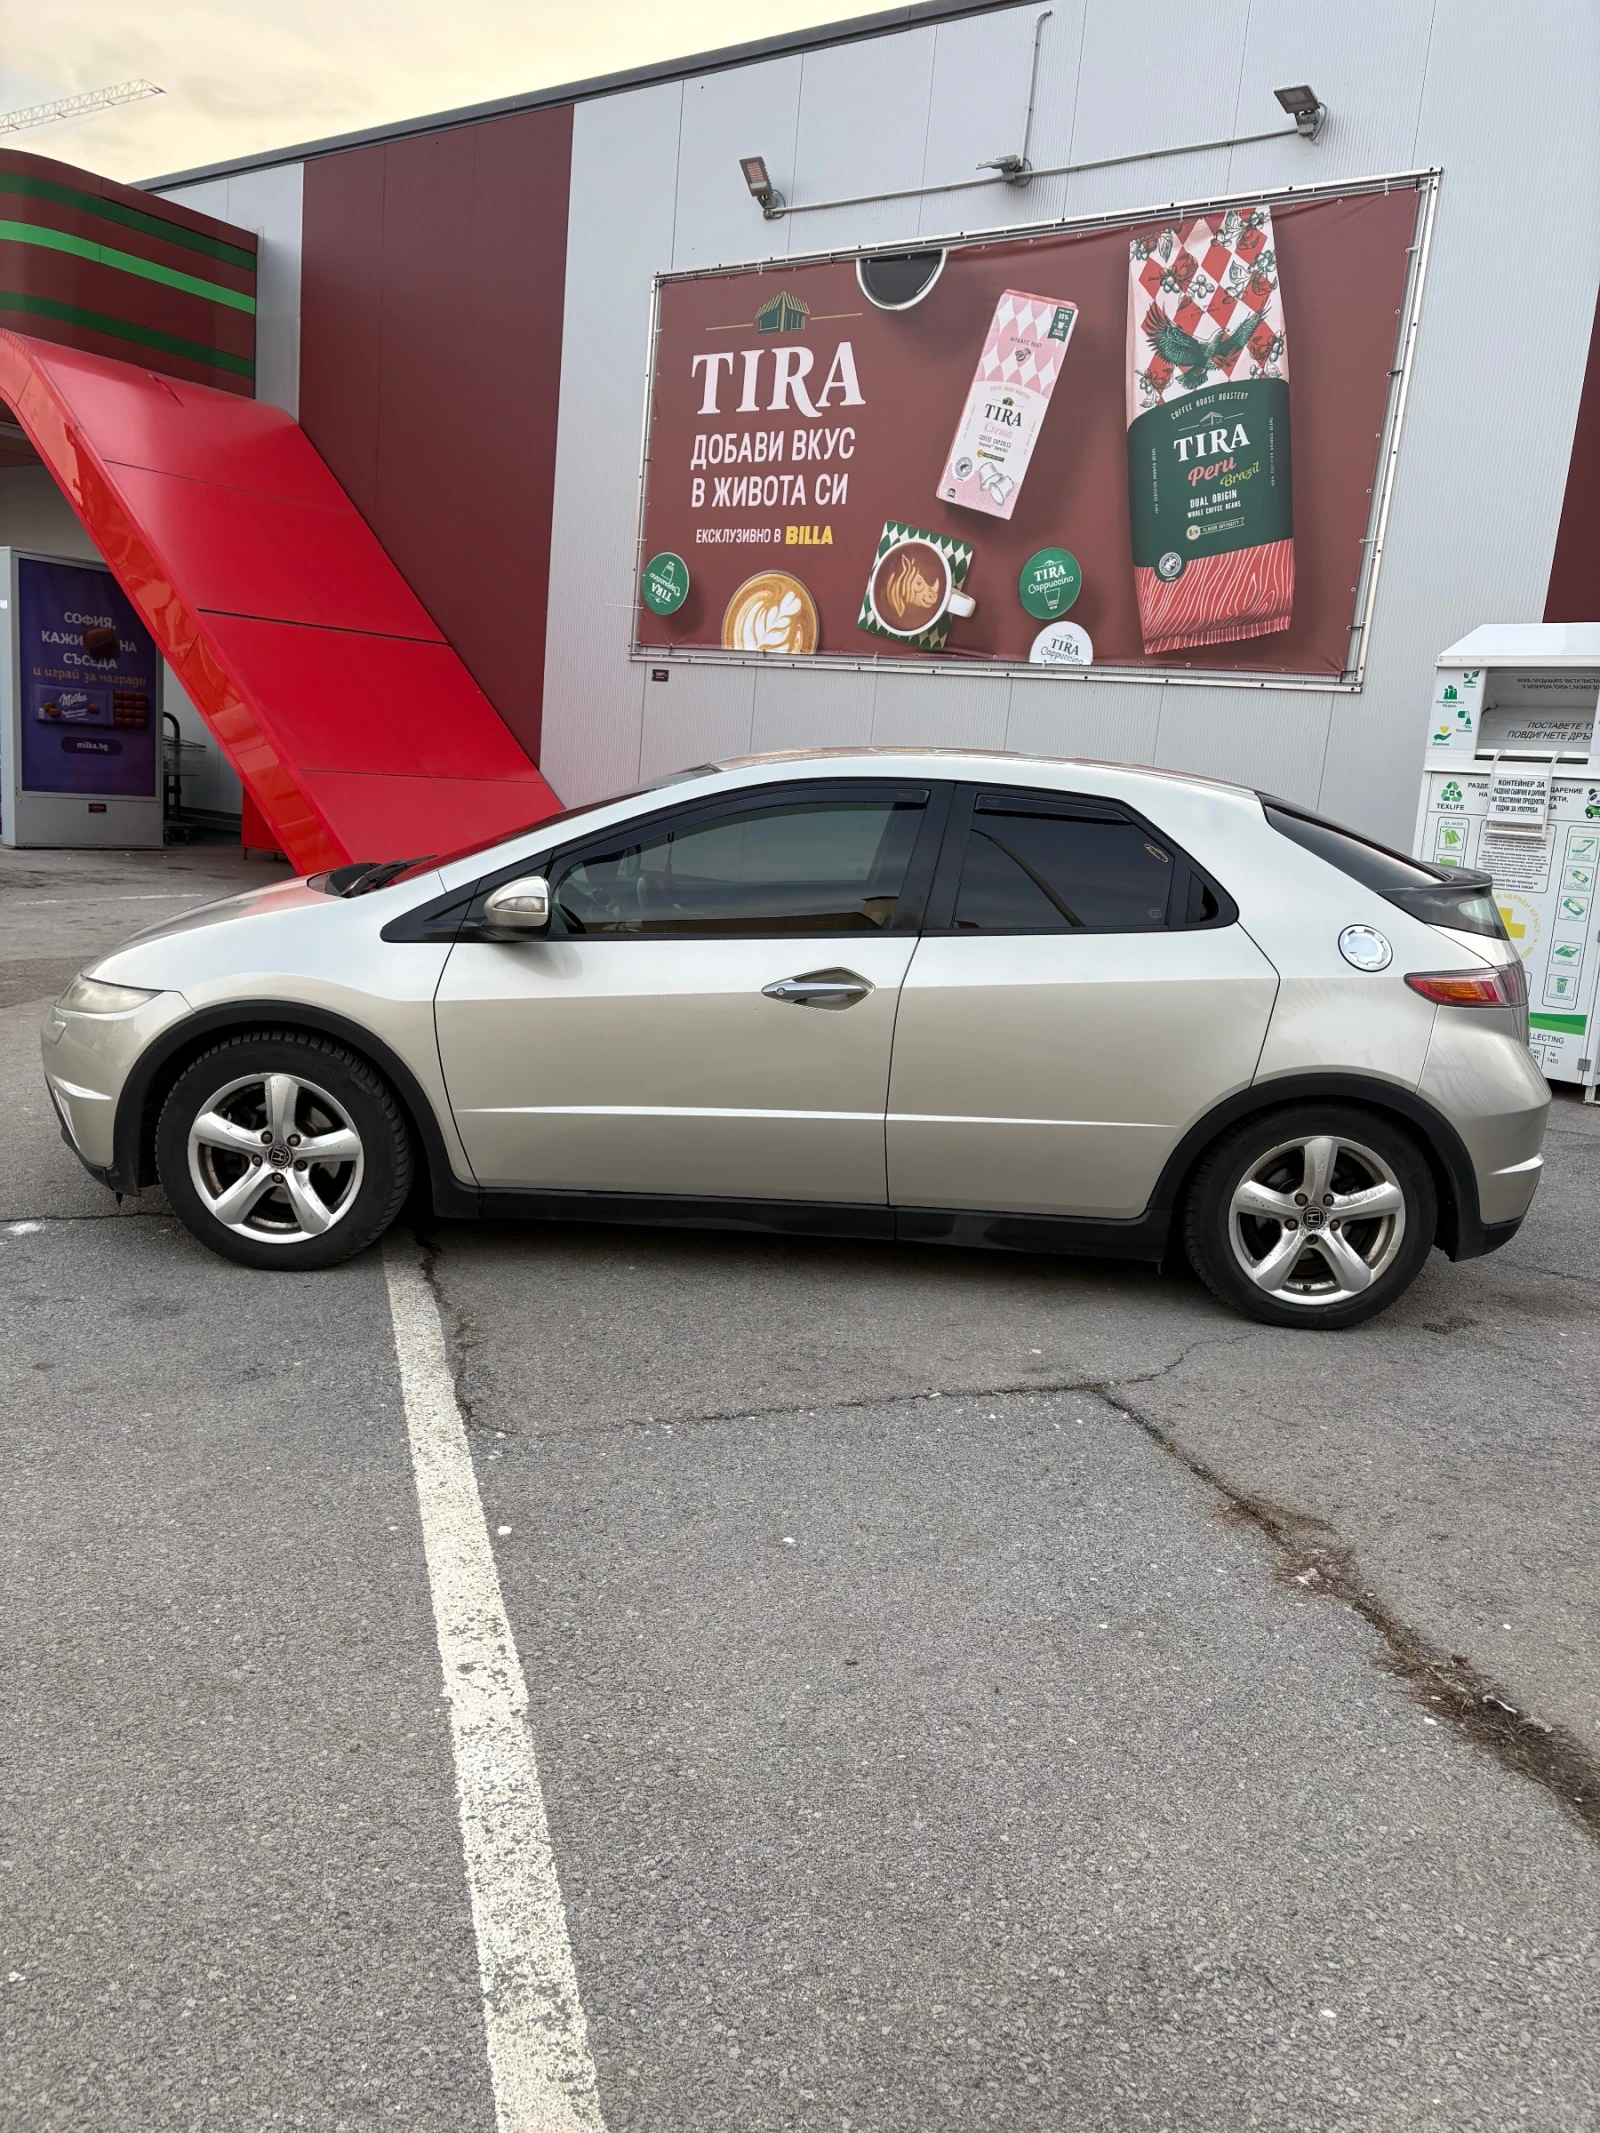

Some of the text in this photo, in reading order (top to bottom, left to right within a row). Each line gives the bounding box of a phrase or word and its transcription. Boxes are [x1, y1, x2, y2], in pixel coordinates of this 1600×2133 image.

[691, 341, 866, 417] TIRA
[985, 403, 1022, 427] TIRA
[1170, 392, 1249, 420] COFFEE HOUSE ROASTERY
[984, 421, 1013, 438] Crema
[690, 427, 855, 470] ДОБАВИ ВКУС
[1173, 423, 1251, 462] TIRA
[1188, 457, 1237, 487] Peru
[1220, 461, 1261, 487] Brazil
[691, 473, 848, 507] В ЖИВОТА СИ
[1190, 489, 1237, 509] DUAL ORIGIN
[1187, 500, 1242, 518] WHOLE COFFEE BEANS
[696, 526, 833, 545] ЕКСКЛУЗИВНО В BILLA
[1034, 565, 1066, 582] TIRA
[651, 582, 672, 602] TIRA
[1028, 575, 1074, 594] Cappuccino
[64, 611, 116, 630] СОФИЯ,
[41, 630, 137, 653] КАЖИ НА
[1051, 638, 1079, 655] TIRA
[63, 652, 117, 670] СЪСЕДА
[45, 669, 79, 680] играй
[59, 692, 87, 707] Milka
[1507, 730, 1568, 740] ПОВДИГНЕТЕ
[1527, 722, 1583, 730] ПОСТАВЕТЕ
[77, 742, 108, 751] milka.bg
[1498, 779, 1535, 787] КОНТЕЙНЕР
[1503, 893, 1531, 908] ЧЕРВЕН
[1530, 908, 1540, 933] КРЪСТ
[1530, 1033, 1564, 1044] LLECTING
